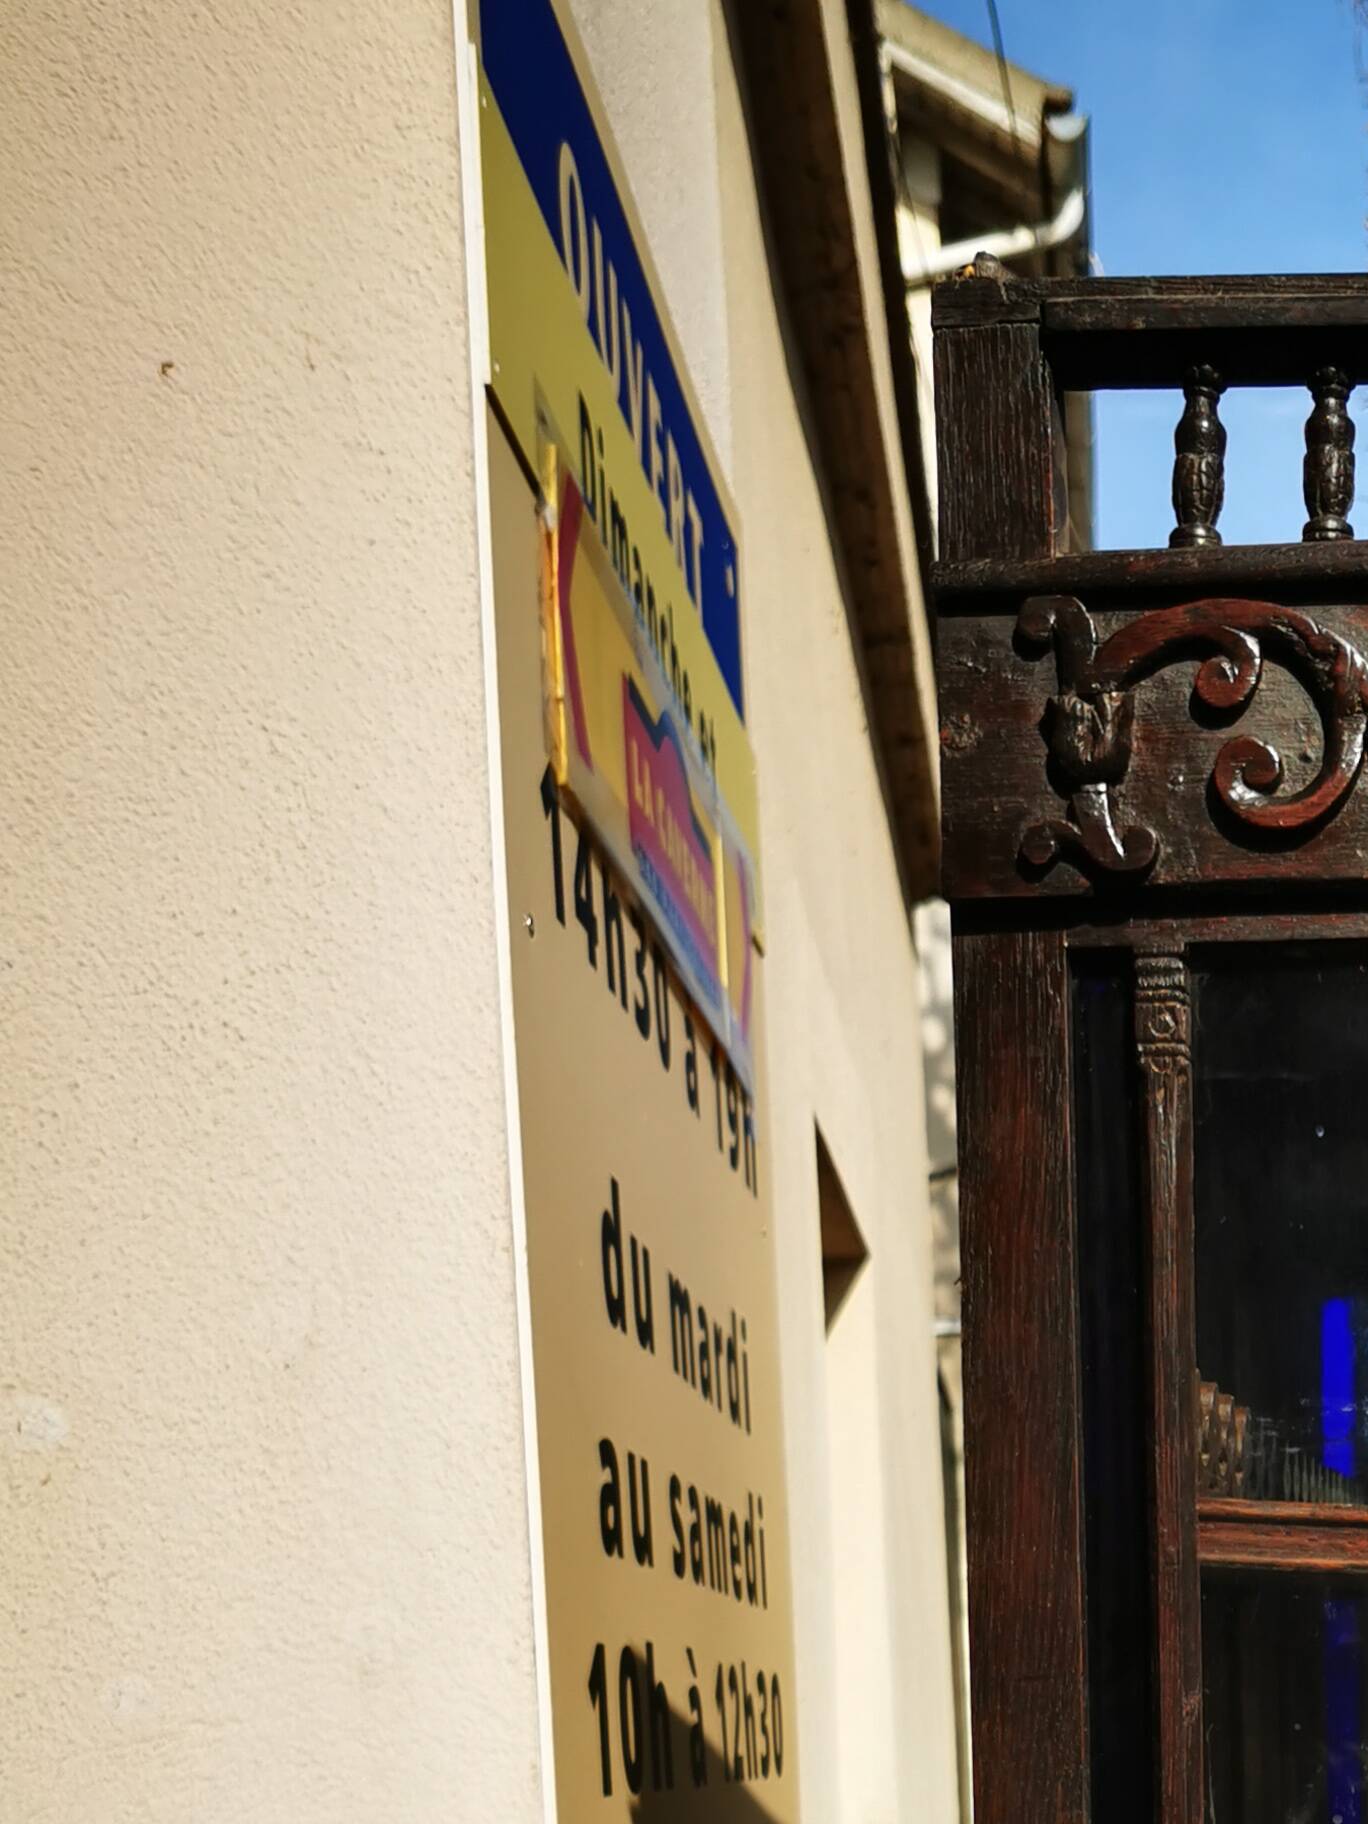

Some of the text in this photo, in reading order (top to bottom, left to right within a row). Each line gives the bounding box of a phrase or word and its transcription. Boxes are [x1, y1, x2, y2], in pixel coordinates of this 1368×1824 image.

[559, 141, 704, 626] OUVERT
[599, 1173, 752, 1435] du mardi
[598, 1436, 768, 1610] au samedi
[588, 1640, 785, 1797] 10h à 12h30
